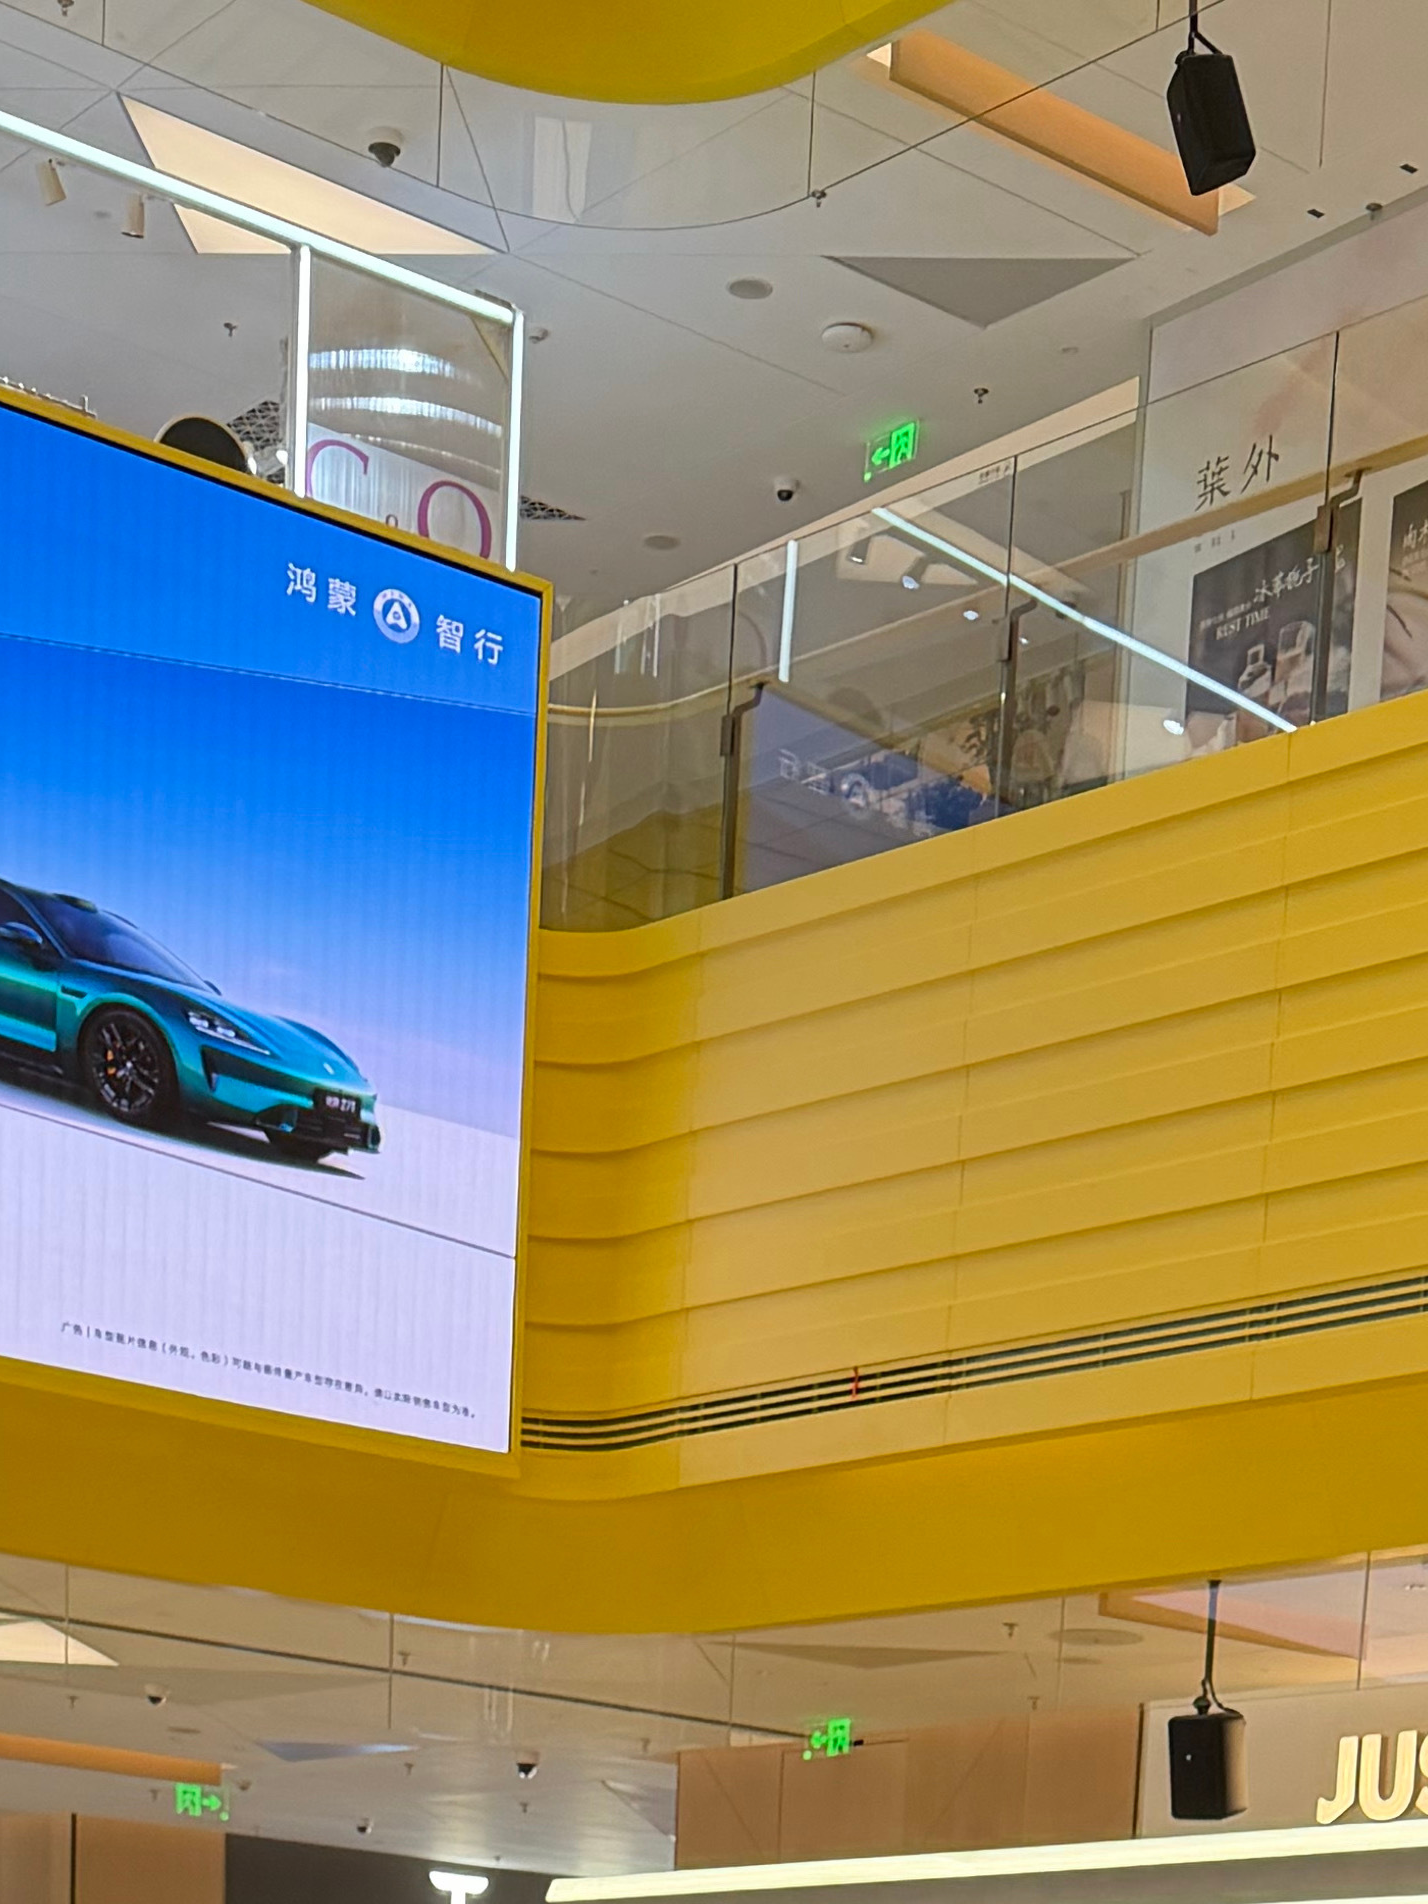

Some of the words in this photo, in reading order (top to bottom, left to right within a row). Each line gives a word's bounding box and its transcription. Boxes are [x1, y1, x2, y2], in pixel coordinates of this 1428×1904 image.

[1194, 434, 1280, 512] 葉外
[285, 562, 357, 617] 鸿蒙
[435, 614, 504, 666] 智行
